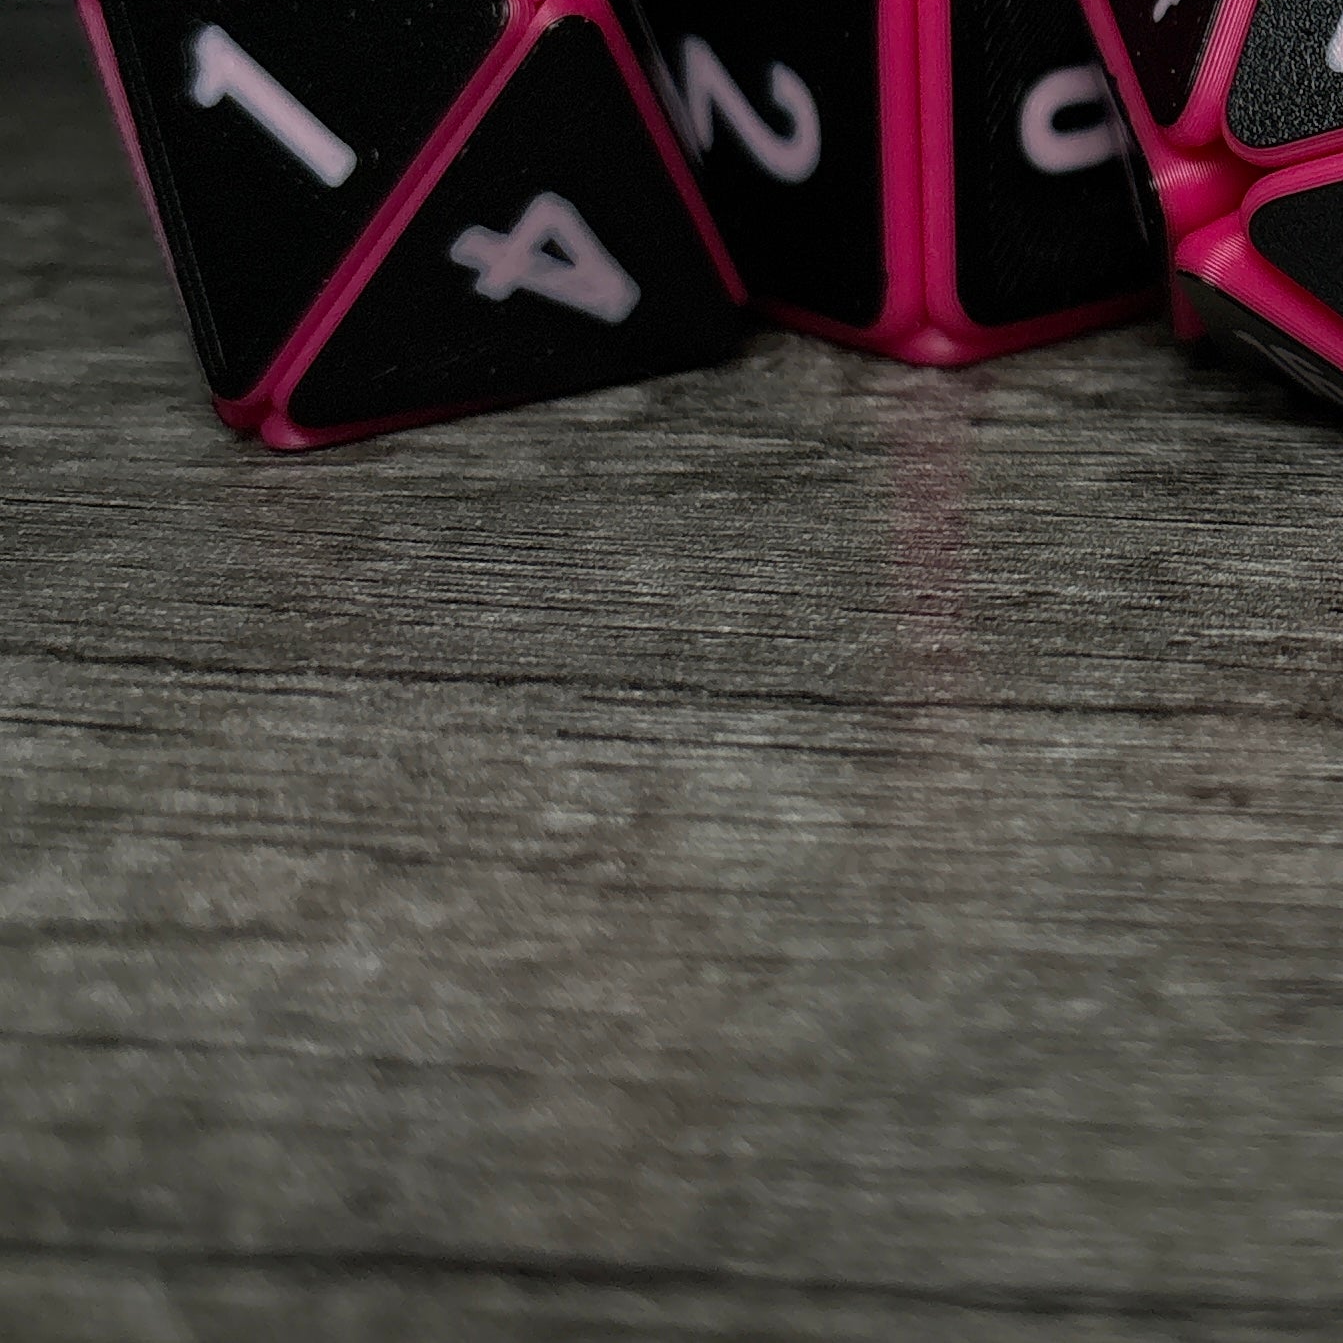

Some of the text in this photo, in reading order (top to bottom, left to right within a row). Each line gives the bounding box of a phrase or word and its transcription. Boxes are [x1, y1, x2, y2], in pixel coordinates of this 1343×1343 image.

[191, 24, 358, 188] 1
[685, 42, 819, 179] 2
[449, 191, 640, 323] 4
